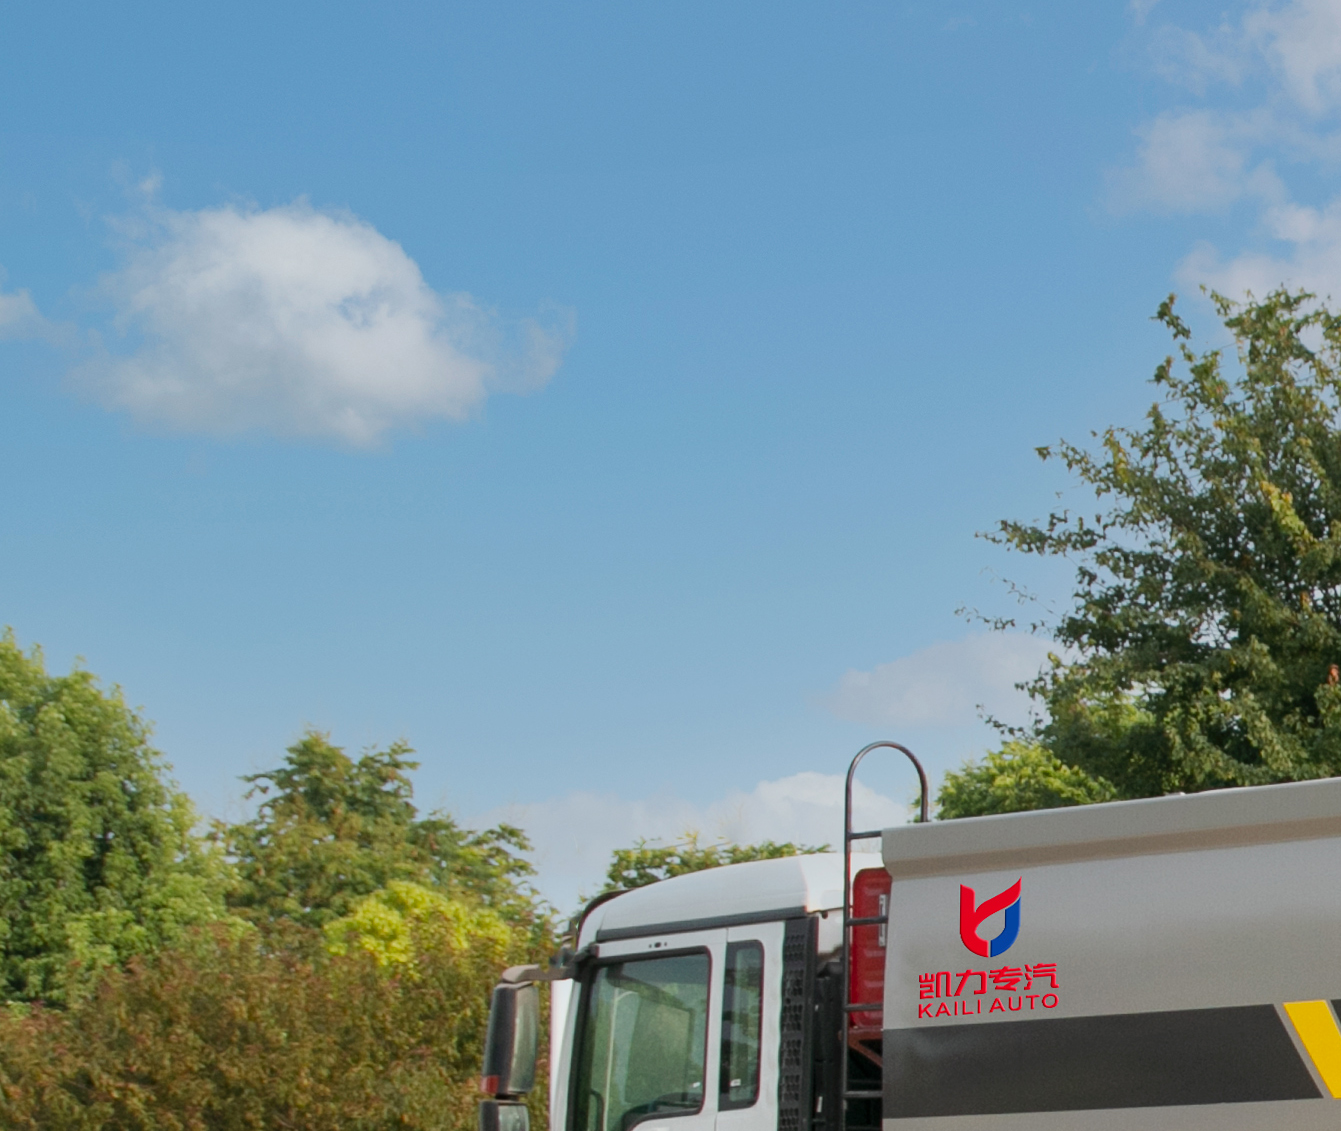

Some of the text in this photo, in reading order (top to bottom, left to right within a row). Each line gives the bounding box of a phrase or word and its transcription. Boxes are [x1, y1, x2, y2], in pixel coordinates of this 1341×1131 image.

[918, 962, 1060, 999] 凯力专汽
[918, 993, 1060, 1018] KAILI AUTO
